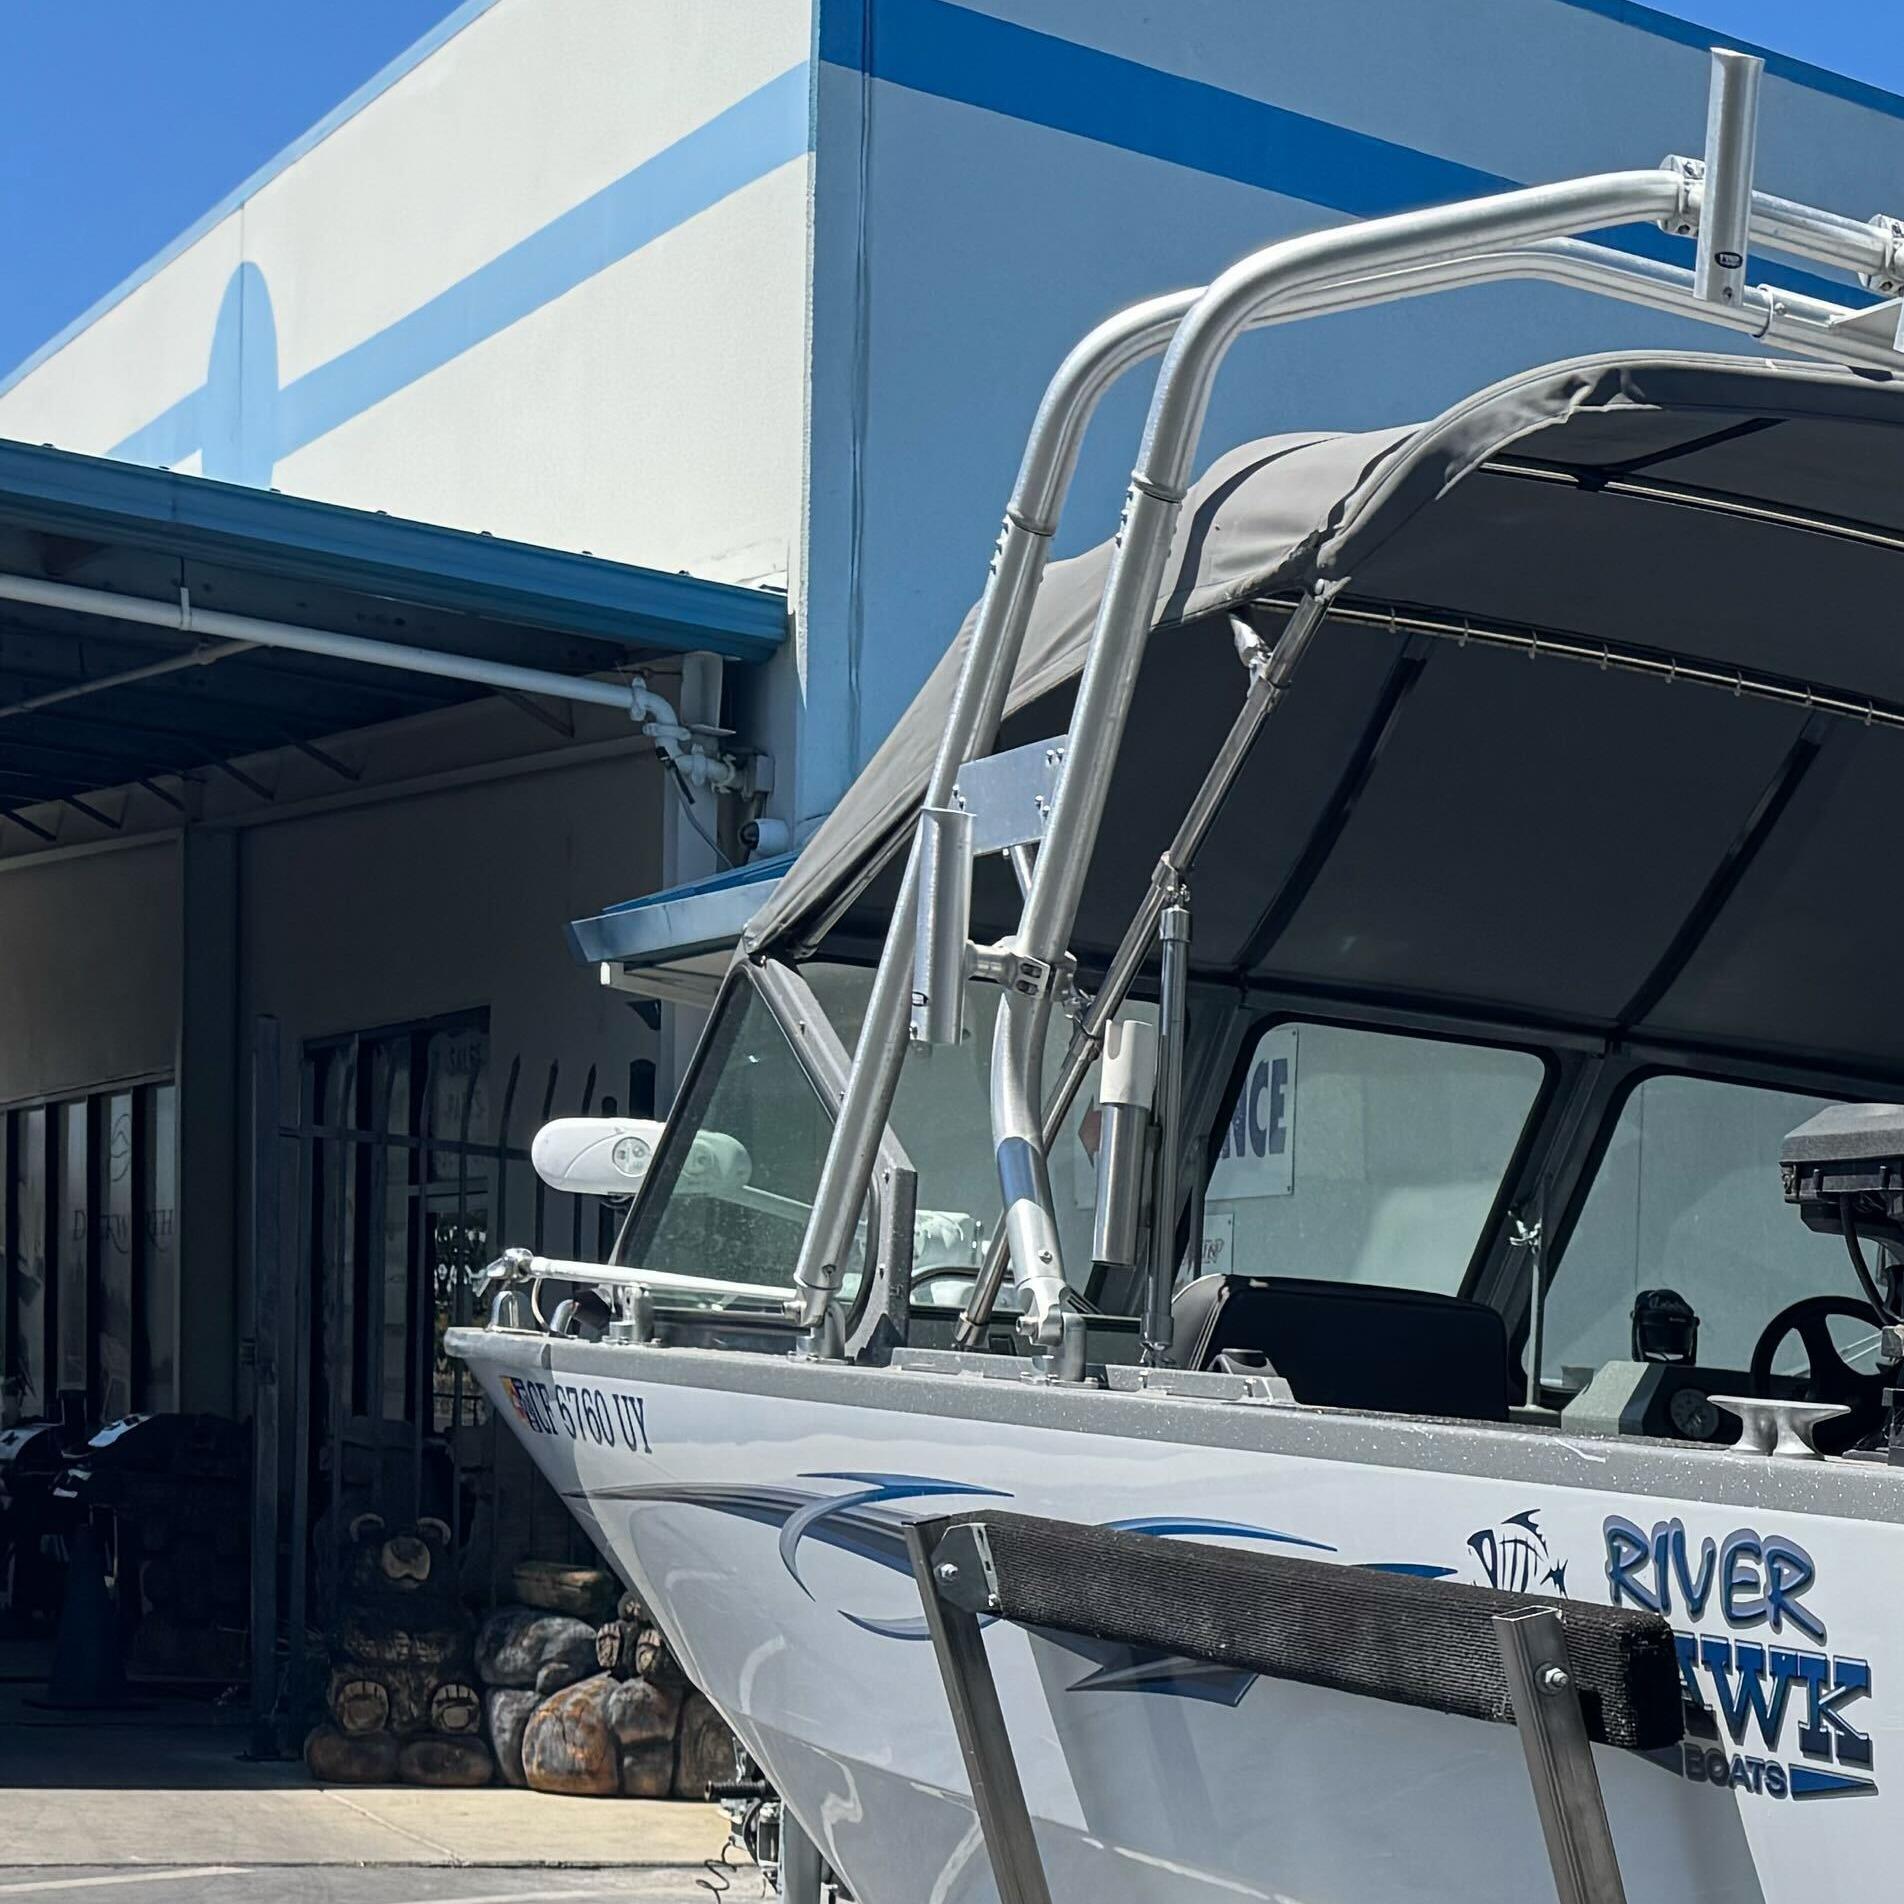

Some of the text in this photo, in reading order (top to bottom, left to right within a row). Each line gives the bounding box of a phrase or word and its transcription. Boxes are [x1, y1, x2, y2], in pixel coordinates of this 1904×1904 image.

[555, 1383, 615, 1448] 6760
[612, 1393, 653, 1455] UY
[1602, 1514, 1828, 1647] RIVER
[1673, 1630, 1875, 1771] AWK
[1683, 1743, 1789, 1800] BOATS
